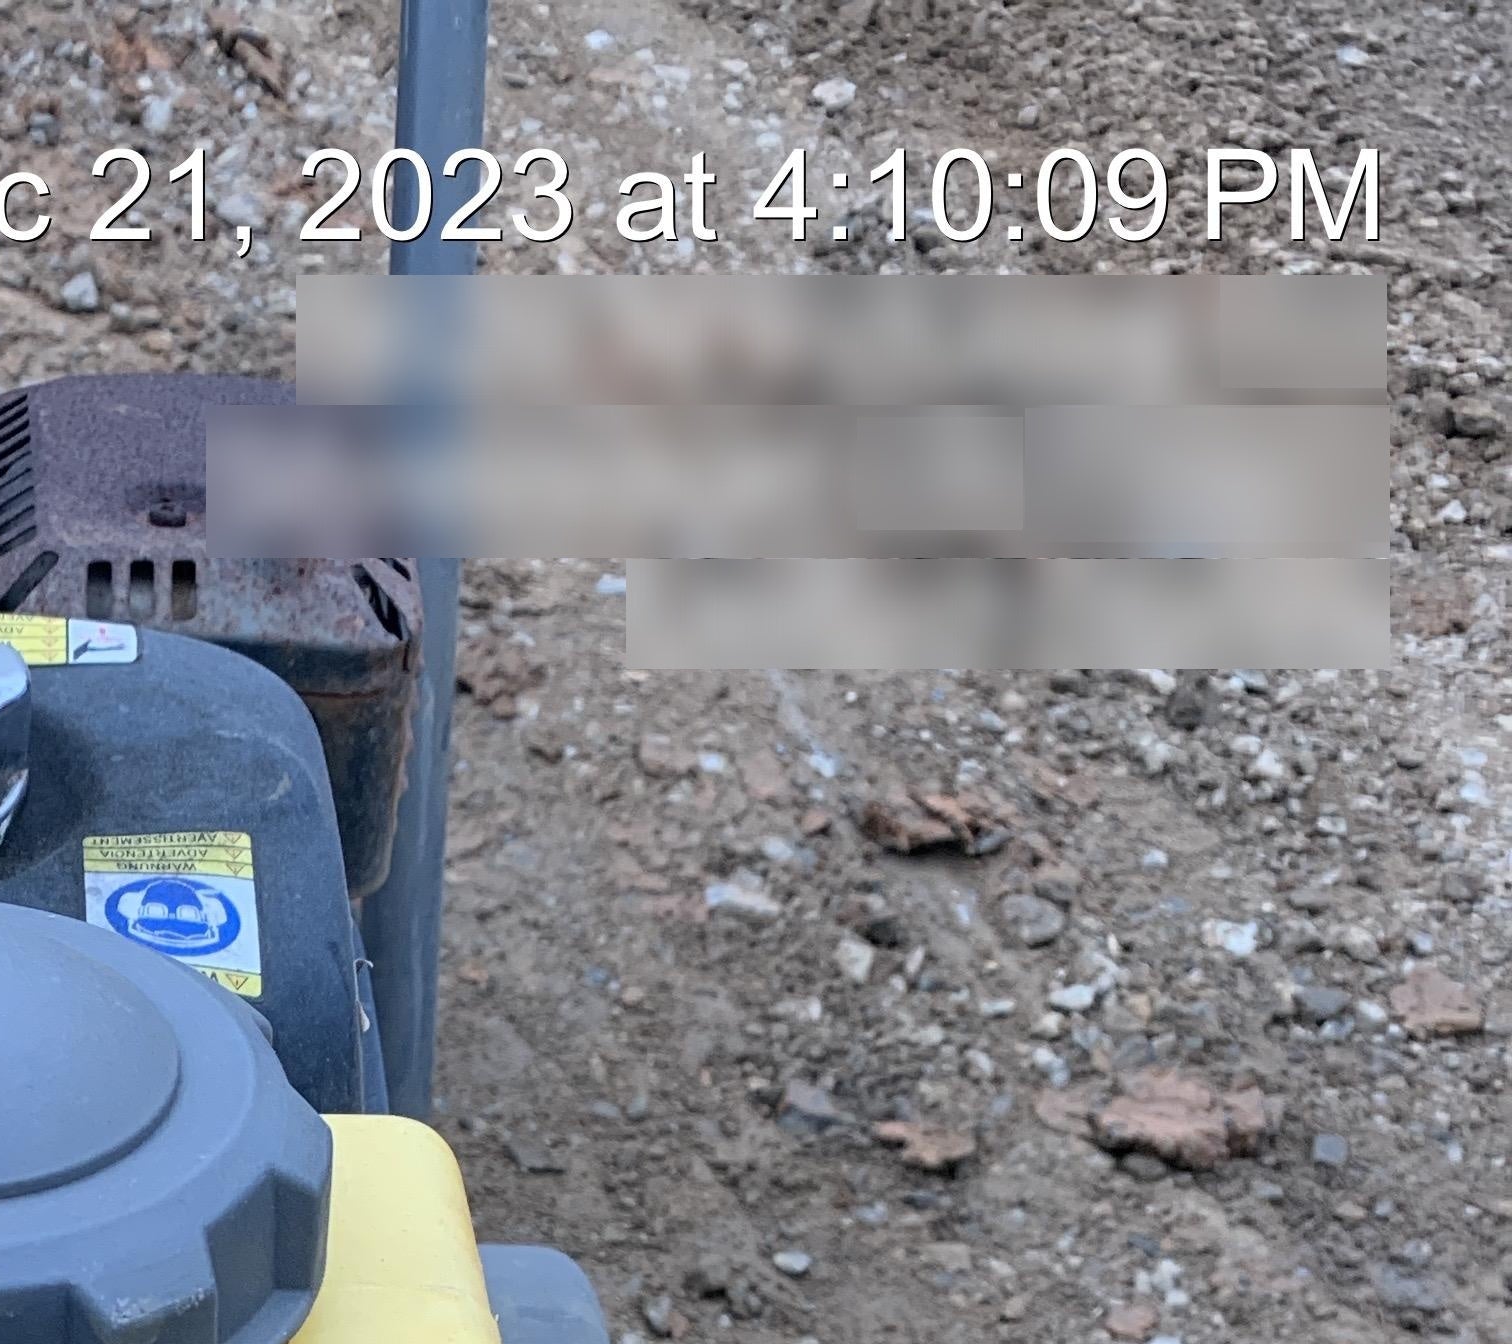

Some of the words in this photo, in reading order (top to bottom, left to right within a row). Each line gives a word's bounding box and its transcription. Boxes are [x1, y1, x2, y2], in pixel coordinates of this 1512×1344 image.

[91, 832, 218, 846] AVERTISSEMENT
[99, 848, 208, 860] ADVERTENCIA
[116, 861, 197, 872] WARNUNG
